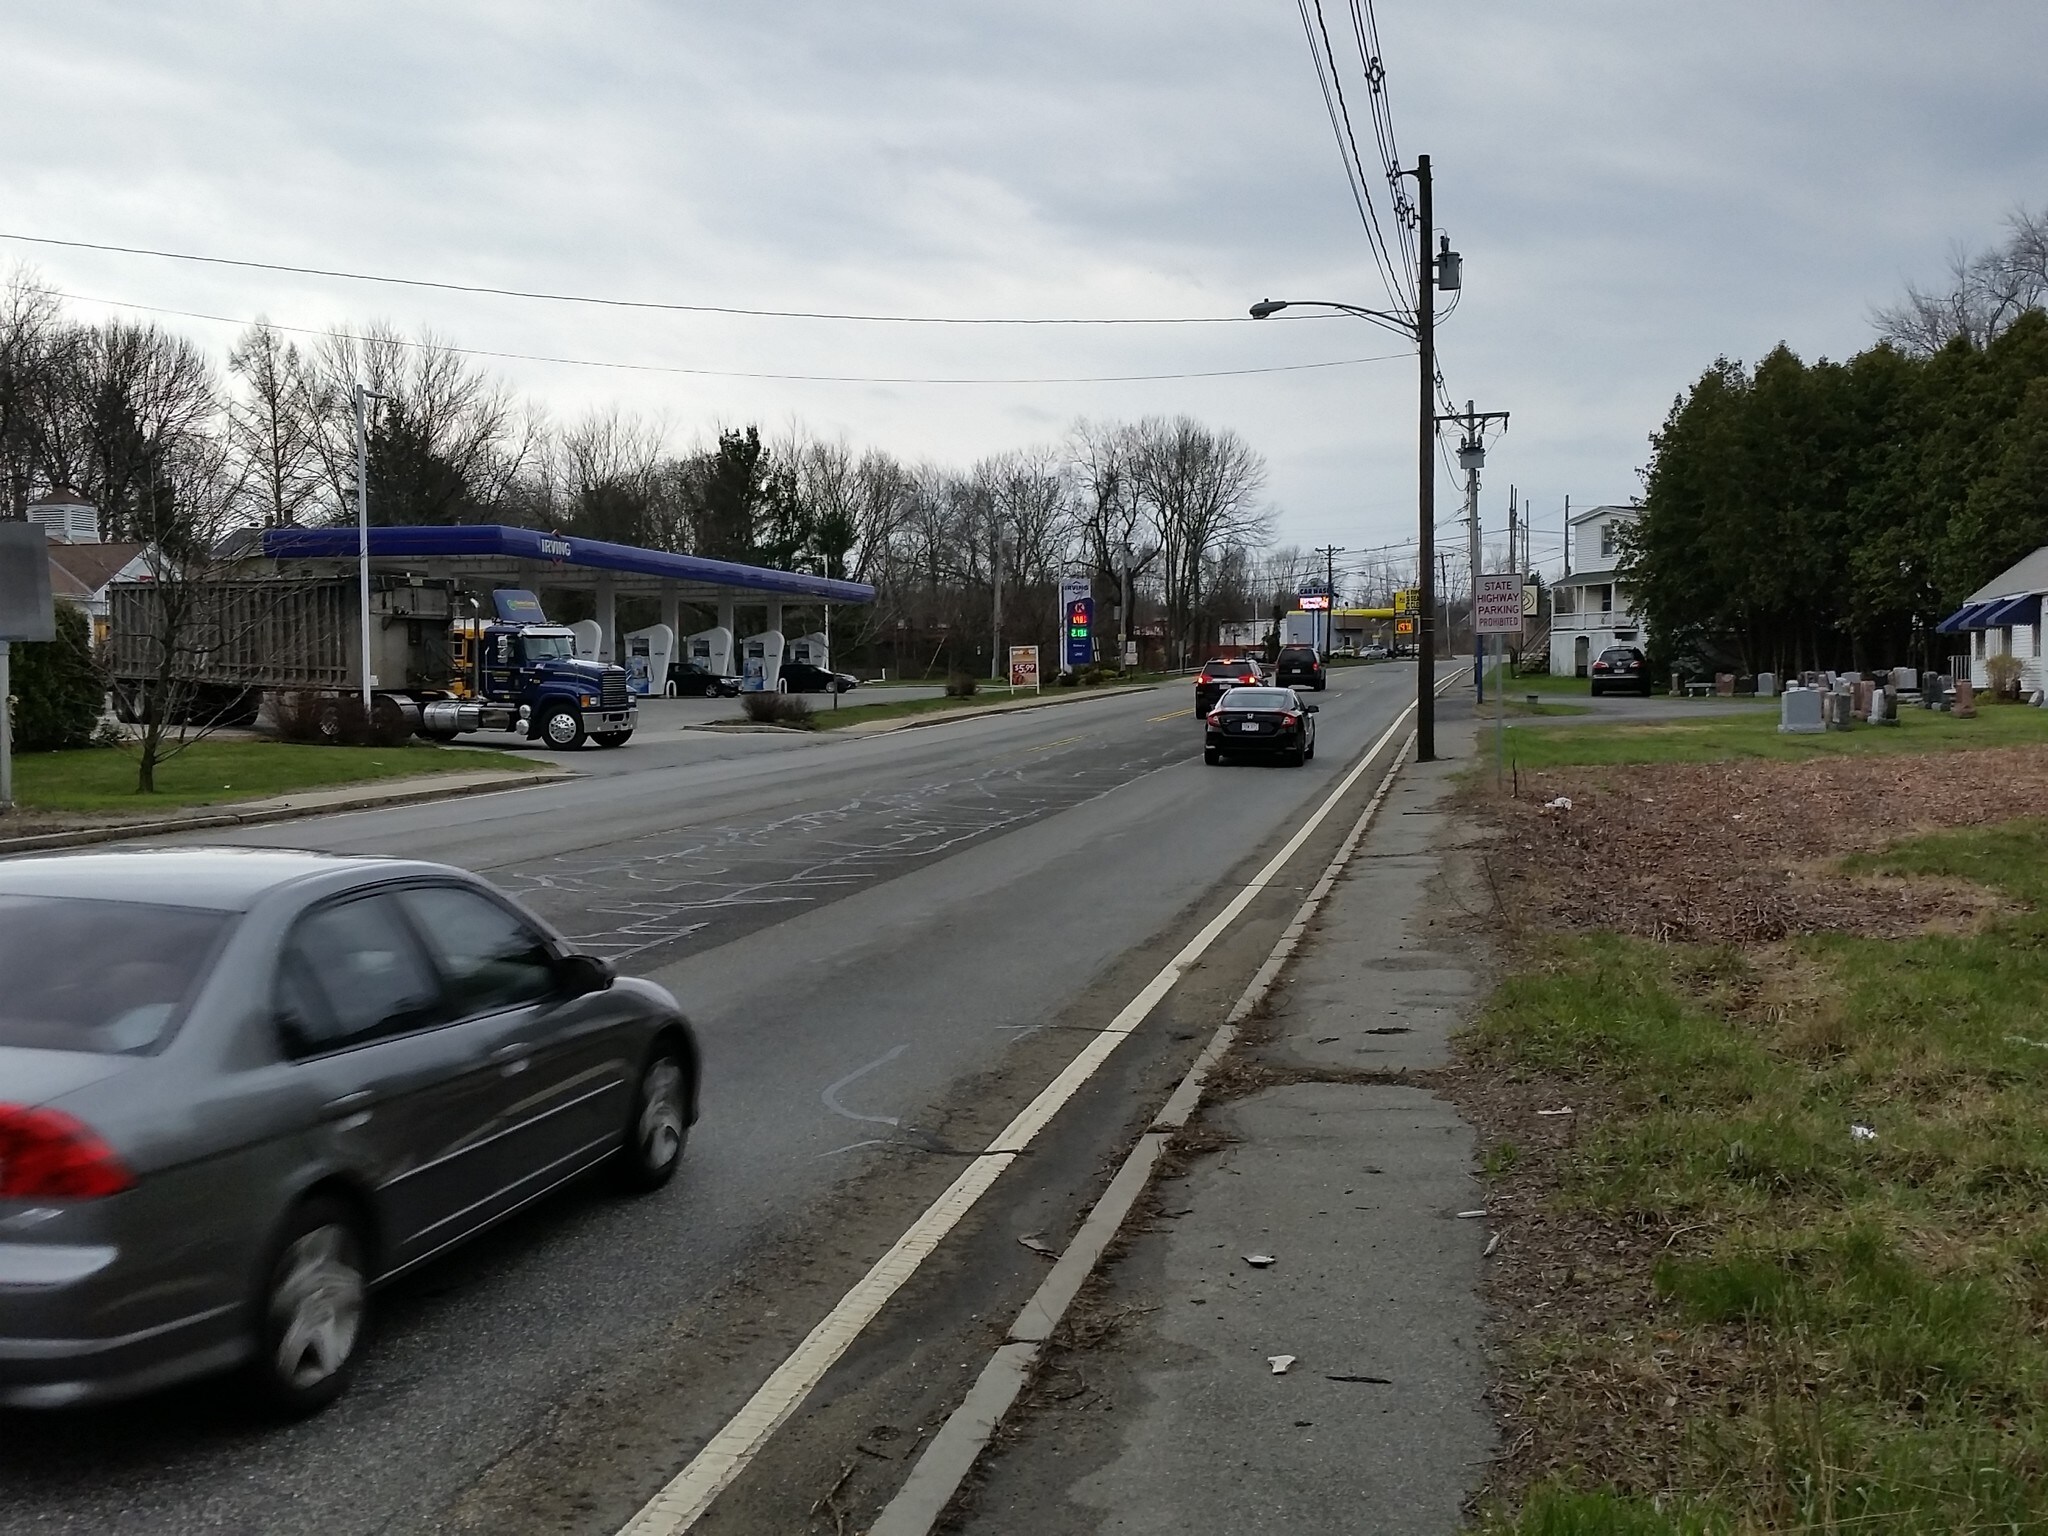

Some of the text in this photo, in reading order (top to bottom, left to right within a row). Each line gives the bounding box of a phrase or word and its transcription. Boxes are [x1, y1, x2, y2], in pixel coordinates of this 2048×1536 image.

[541, 539, 571, 556] IRVING
[1484, 581, 1512, 591] STATE
[1477, 593, 1519, 603] HIGHWAY
[1478, 605, 1519, 615] PARKING
[1479, 617, 1518, 627] PROHIBITED
